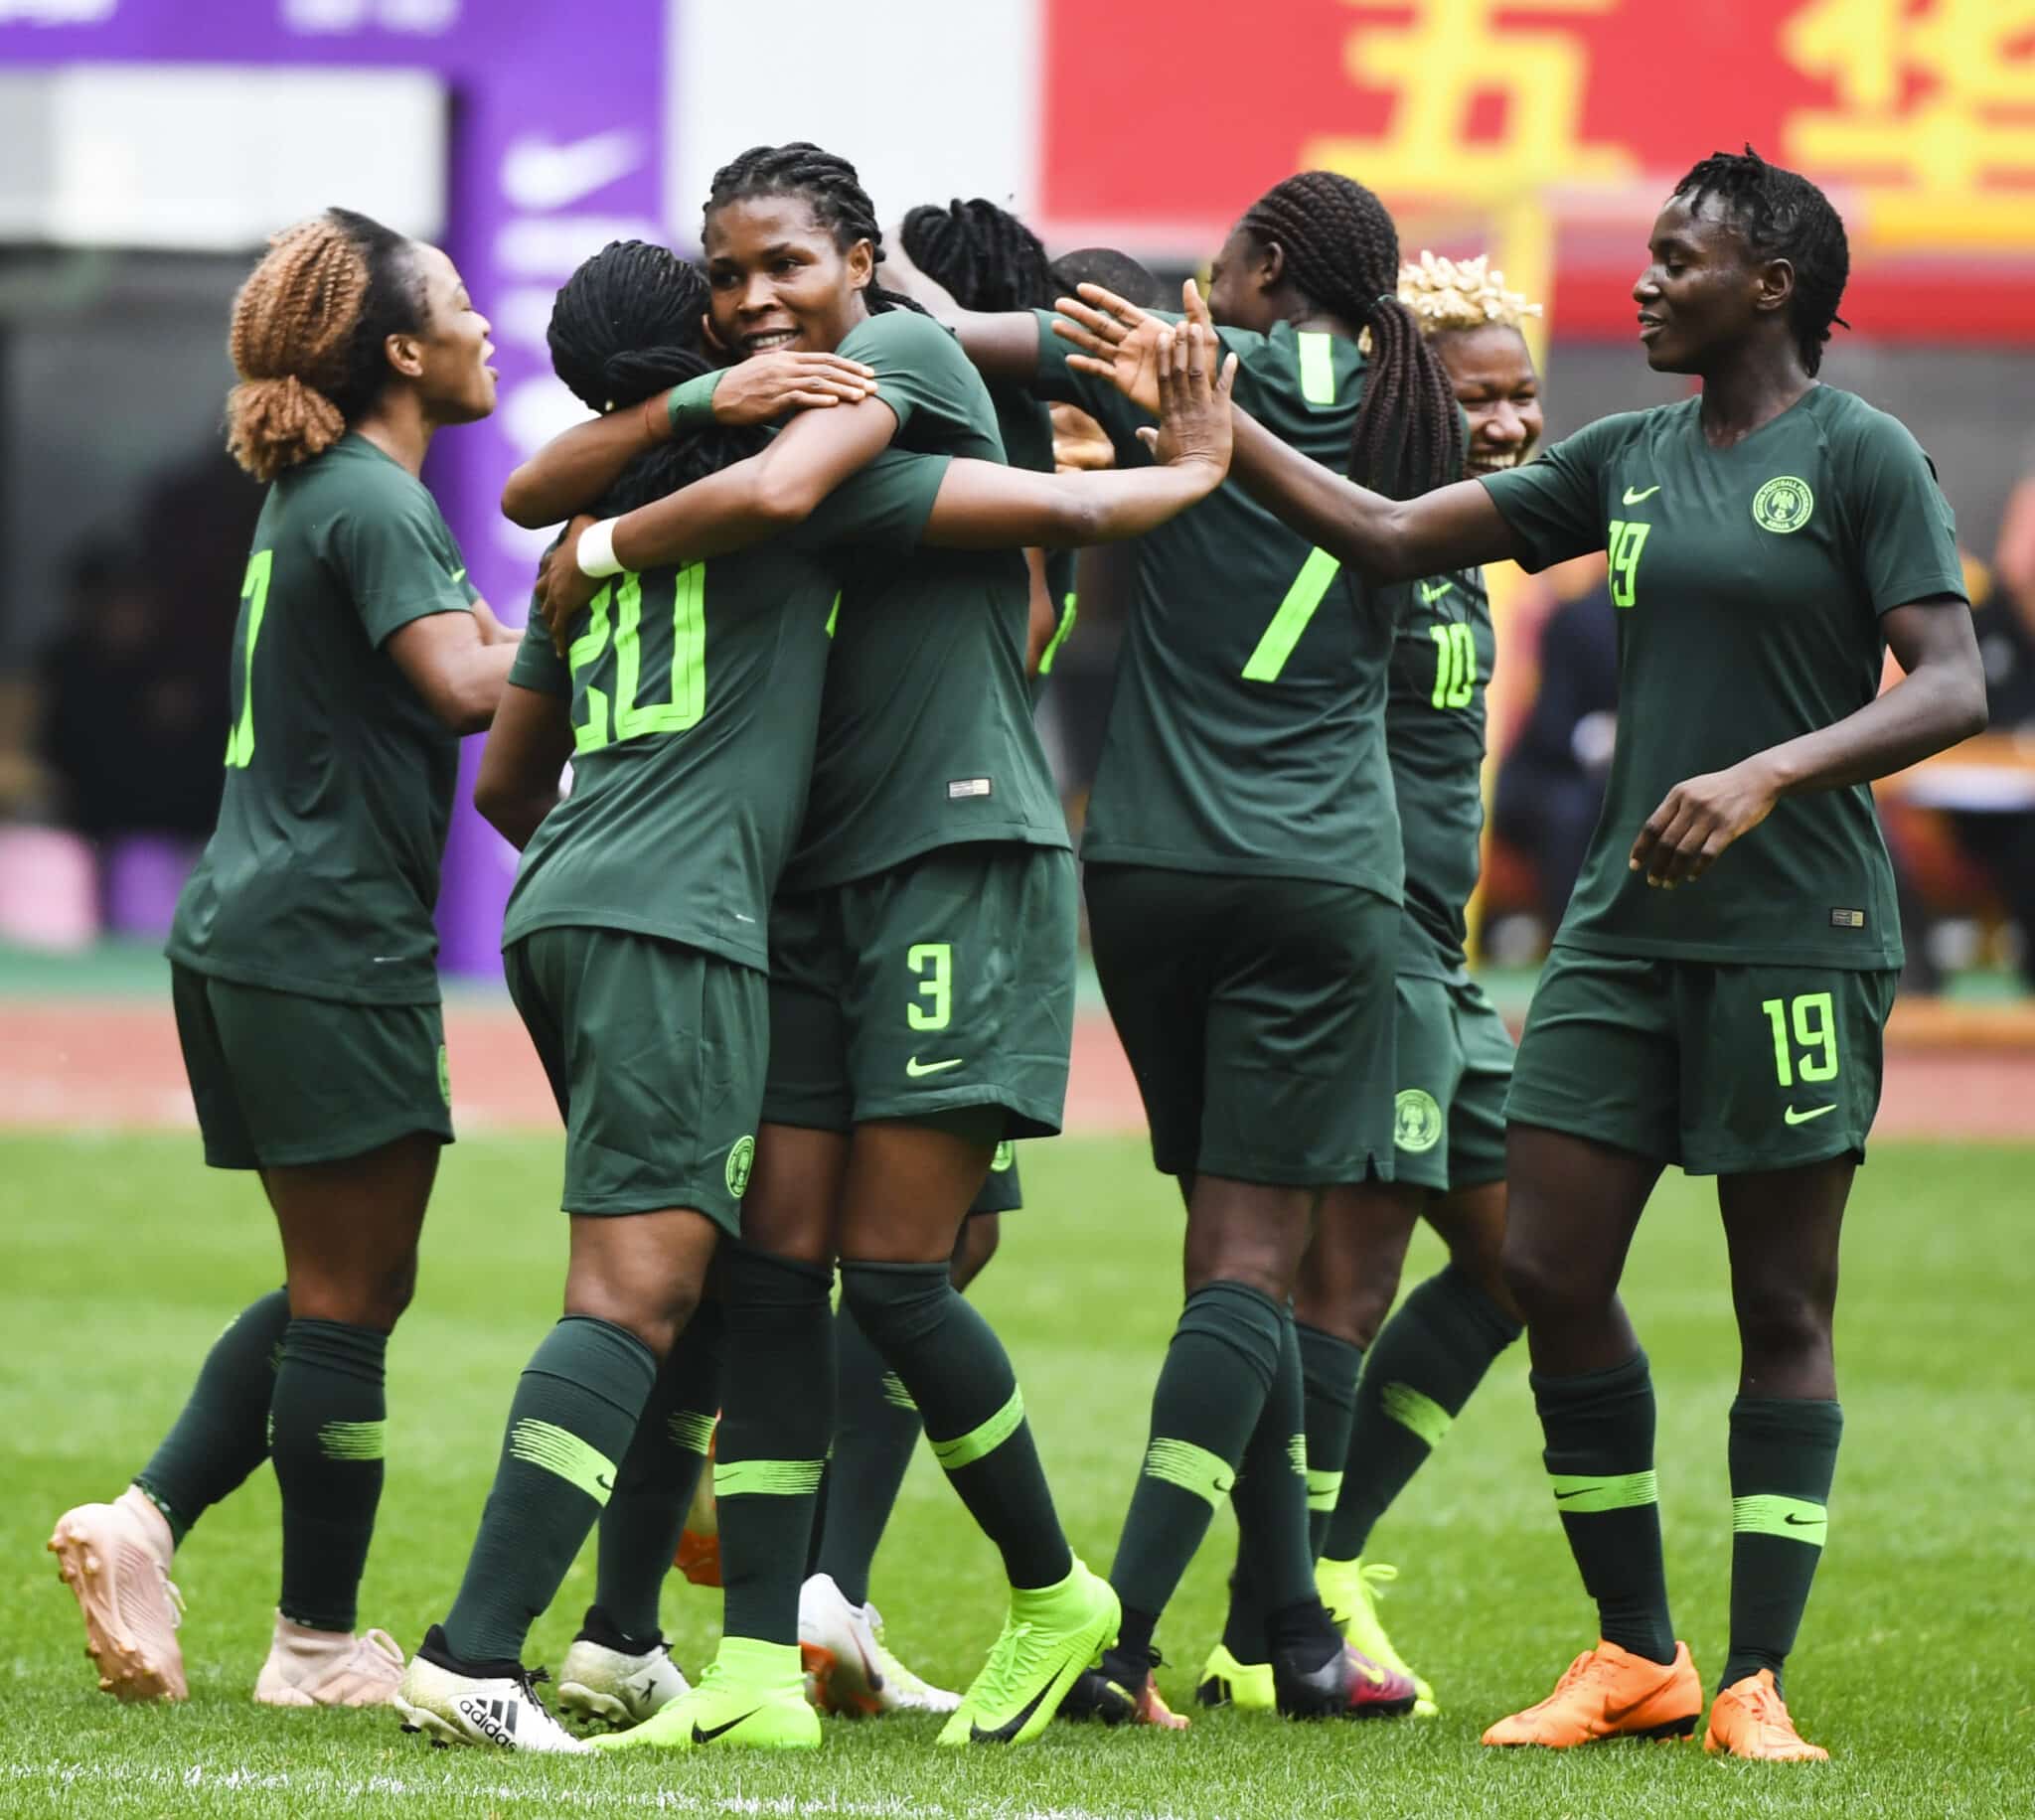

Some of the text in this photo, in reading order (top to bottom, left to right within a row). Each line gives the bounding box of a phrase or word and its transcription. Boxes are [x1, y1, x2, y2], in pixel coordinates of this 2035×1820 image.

[1609, 520, 1651, 607] 19
[1429, 622, 1477, 709] 10
[906, 943, 951, 1031] 3
[1762, 991, 1838, 1087] 19
